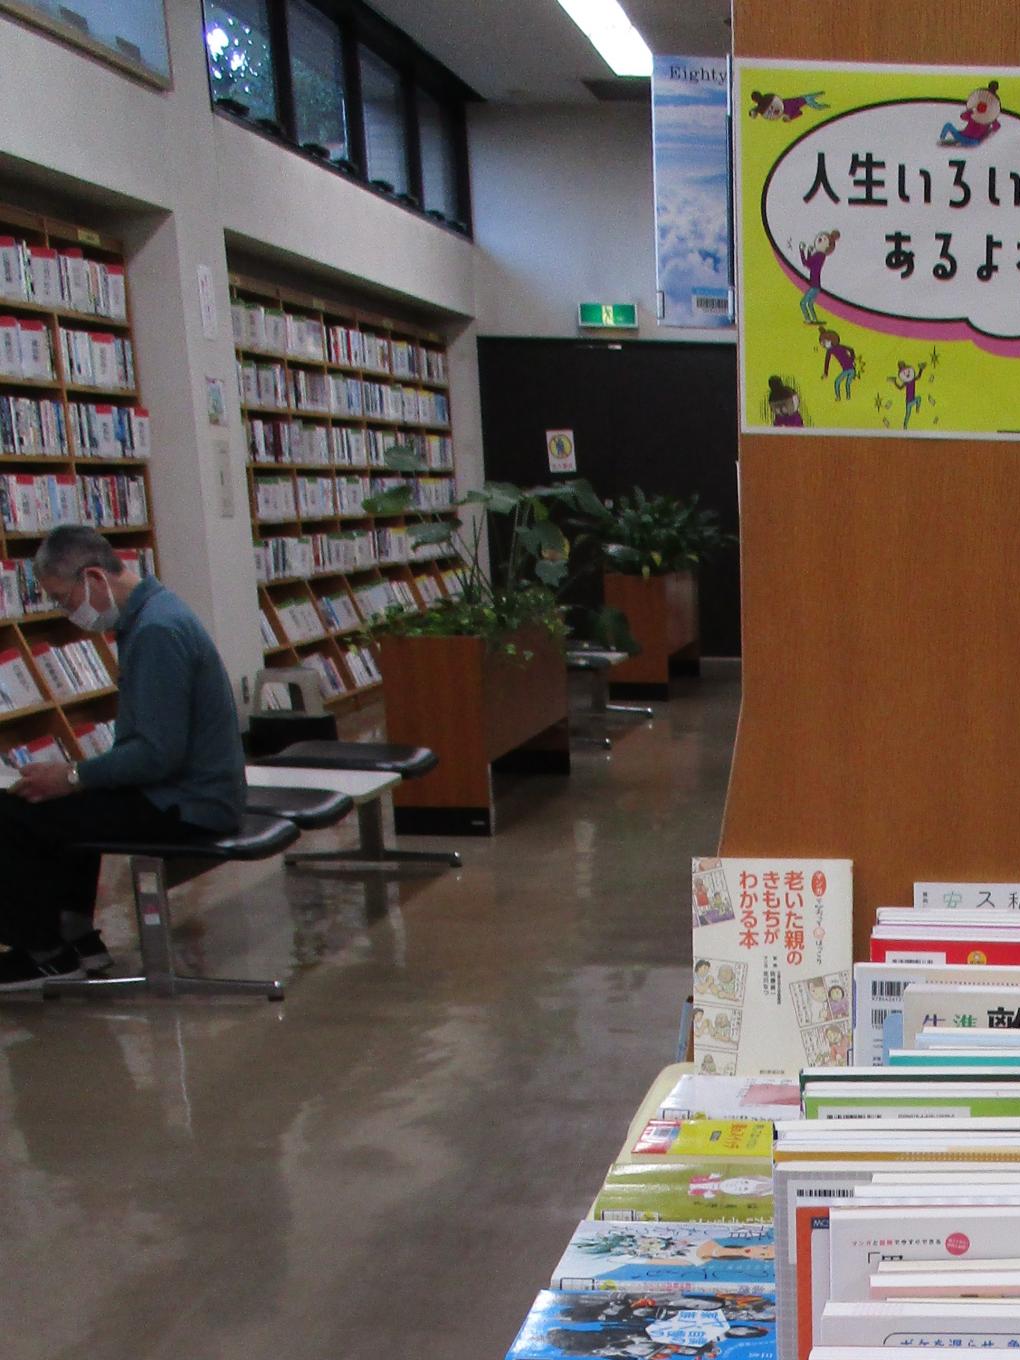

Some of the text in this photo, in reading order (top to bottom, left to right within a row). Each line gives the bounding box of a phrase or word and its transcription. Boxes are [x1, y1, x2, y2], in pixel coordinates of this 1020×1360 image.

[738, 870, 760, 950] わかる本
[762, 870, 781, 946] きもちが
[784, 870, 805, 966] 老いた親の
